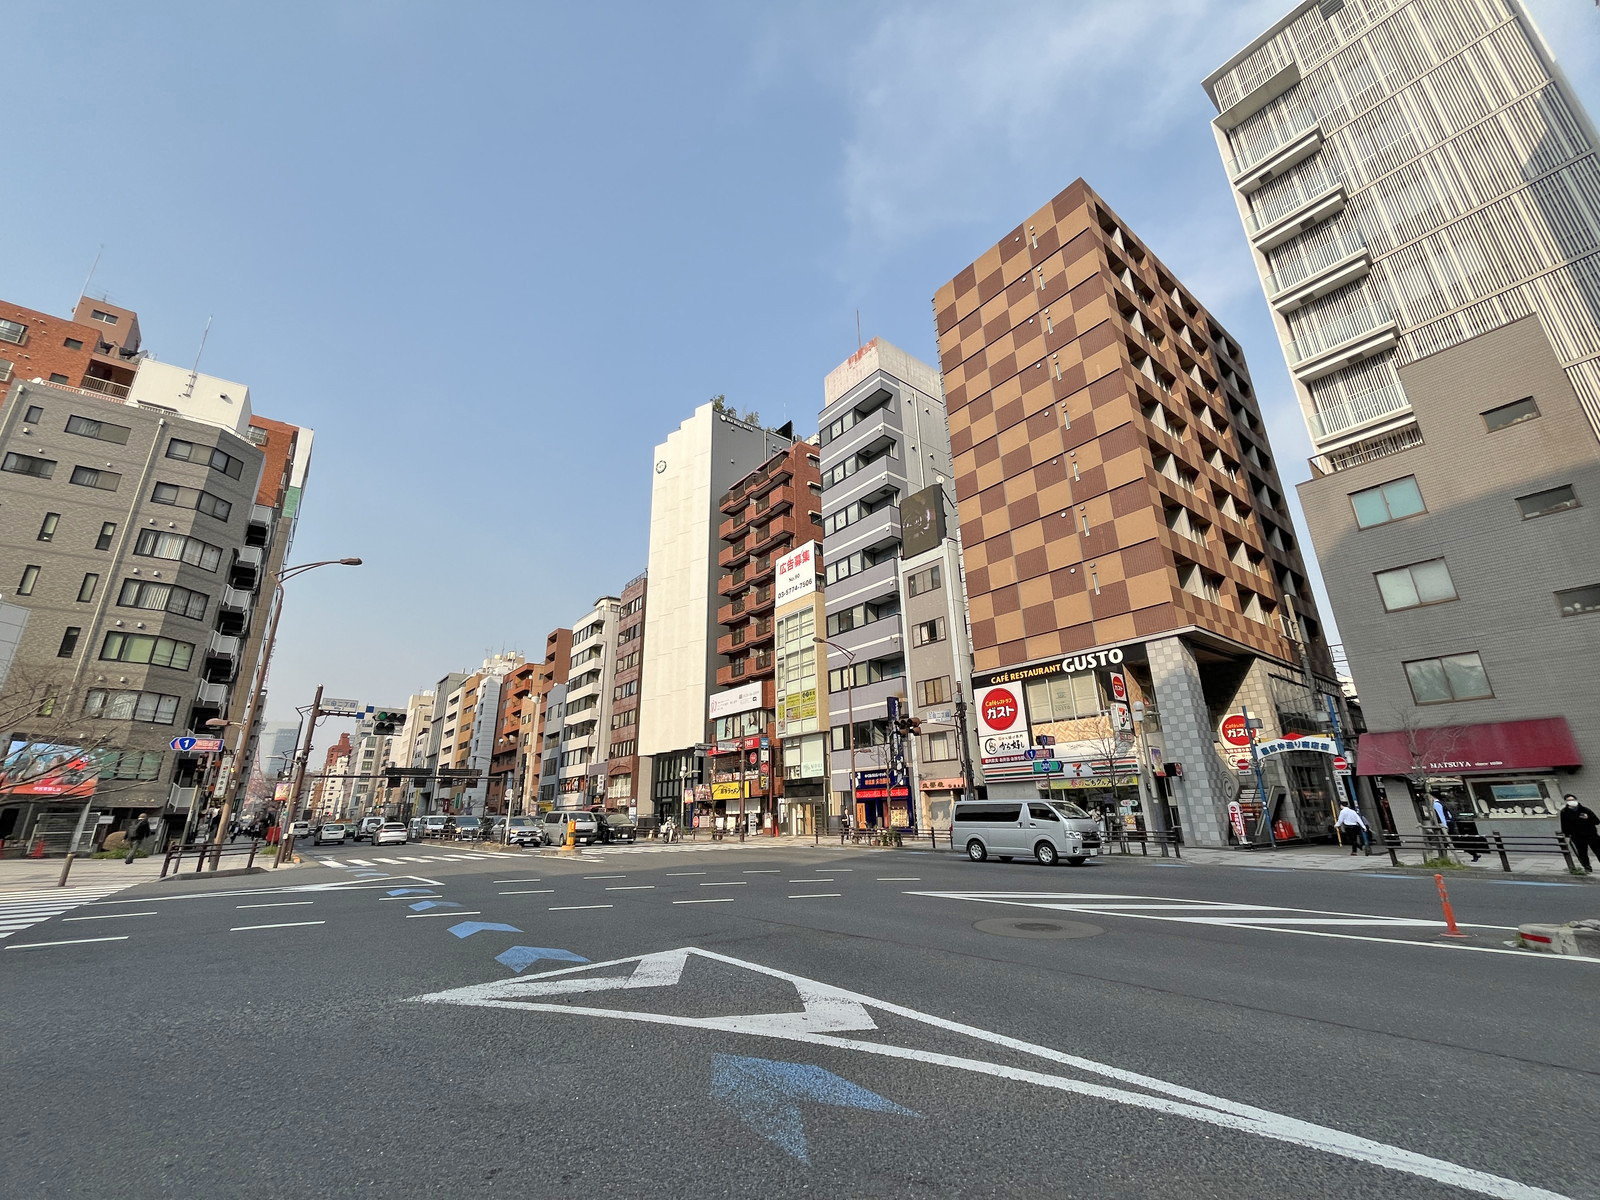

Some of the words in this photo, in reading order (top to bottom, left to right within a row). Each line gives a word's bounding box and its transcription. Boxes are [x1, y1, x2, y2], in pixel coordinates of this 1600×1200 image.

[779, 549, 810, 575] 広告募集
[990, 673, 1009, 684] CAFÉ
[1010, 663, 1061, 682] RESTAURANT
[1062, 648, 1124, 673] GUSTO
[987, 705, 1015, 719] ガスト
[183, 739, 190, 748] 1
[999, 739, 1025, 751] から好し
[1029, 750, 1035, 758] 1
[1429, 760, 1472, 769] MATSUYA
